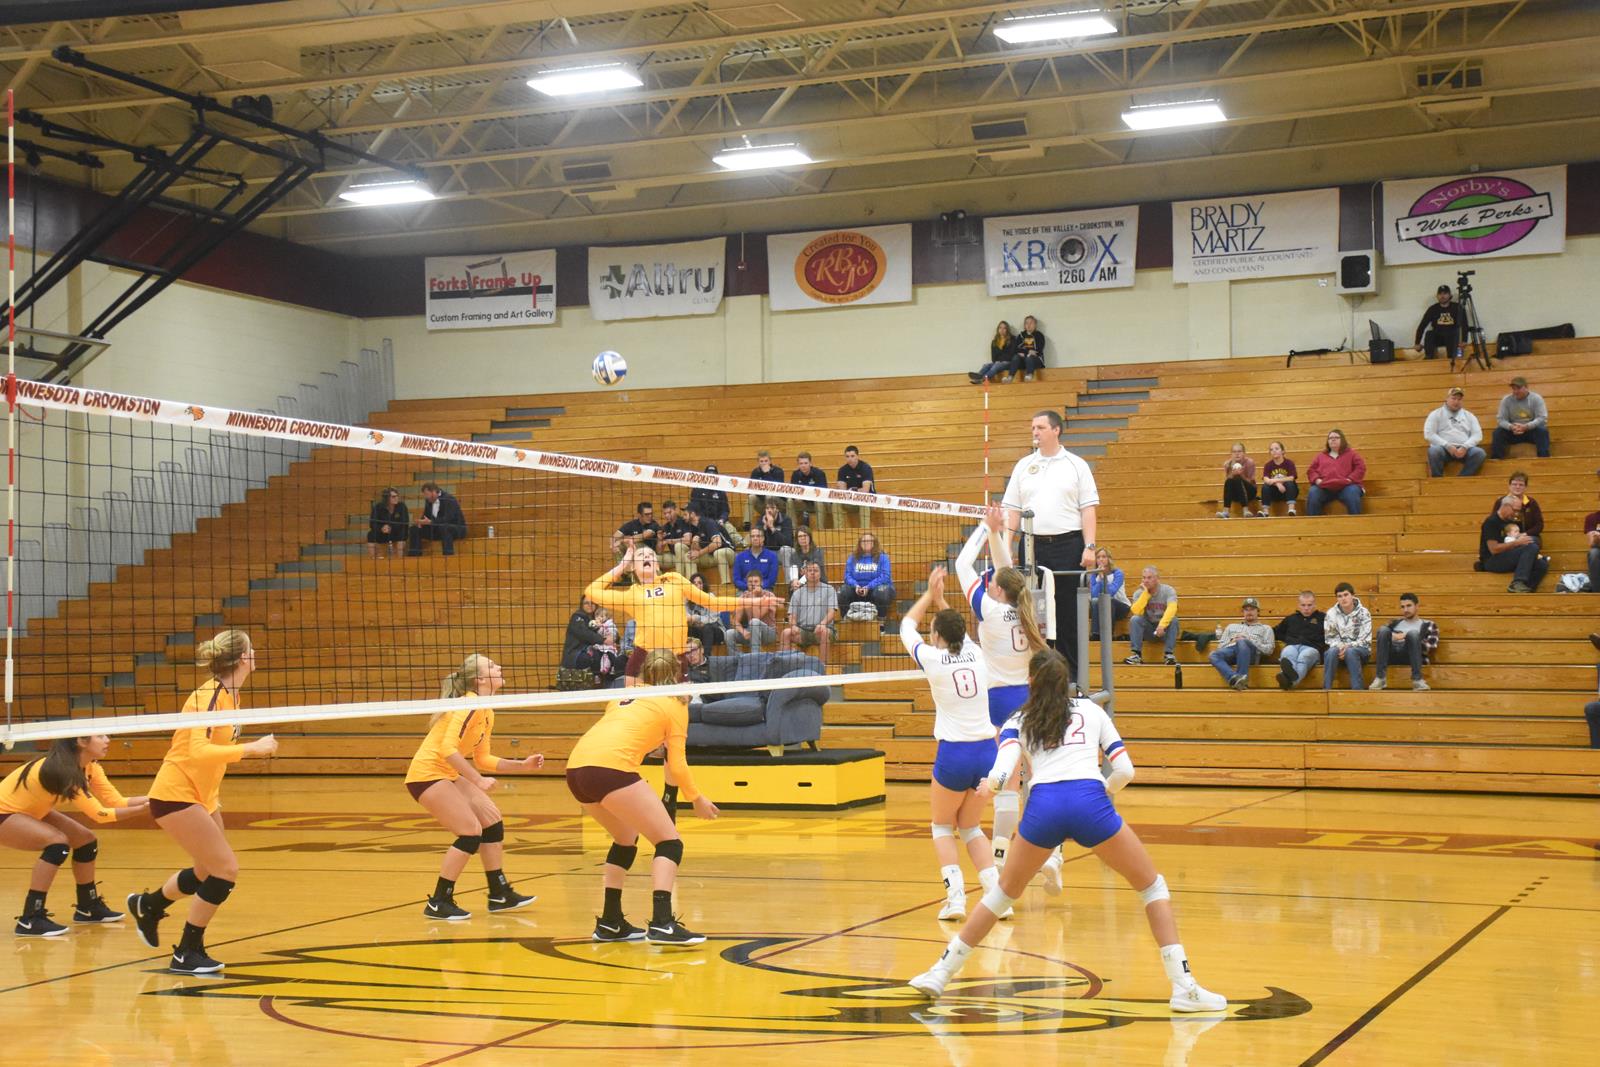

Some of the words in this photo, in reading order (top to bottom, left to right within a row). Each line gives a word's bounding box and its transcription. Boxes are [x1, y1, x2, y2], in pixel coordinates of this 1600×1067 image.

[1428, 180, 1510, 209] Norby's
[1191, 202, 1264, 231] BRADY
[1417, 214, 1470, 232] Work
[1478, 204, 1533, 223] Perks
[1015, 227, 1031, 236] VOICE
[1032, 226, 1040, 234] OF
[1041, 225, 1051, 233] THE
[1053, 225, 1074, 233] VALLEY
[1191, 226, 1265, 255] MARTZ
[803, 233, 839, 257] Created
[842, 233, 856, 241] for
[860, 235, 877, 252] You
[429, 276, 467, 290] Forks
[471, 275, 517, 289] Frame
[625, 263, 715, 297] Altru
[1059, 268, 1085, 284] 1260
[1099, 267, 1117, 281] AM
[430, 313, 459, 322] Custom
[461, 312, 491, 322] Framing
[493, 310, 509, 319] and
[510, 310, 523, 318] Art
[525, 309, 553, 319] Gallery
[83, 391, 161, 416] CROOKSTON
[226, 411, 287, 433] MINNESOTA
[290, 420, 350, 441] CROOKSTON
[401, 435, 450, 453] MINNESOTA
[450, 442, 499, 460] CROOKSTON
[539, 454, 578, 469] MINNESOTA
[646, 587, 665, 598] 12
[952, 667, 978, 699] 8
